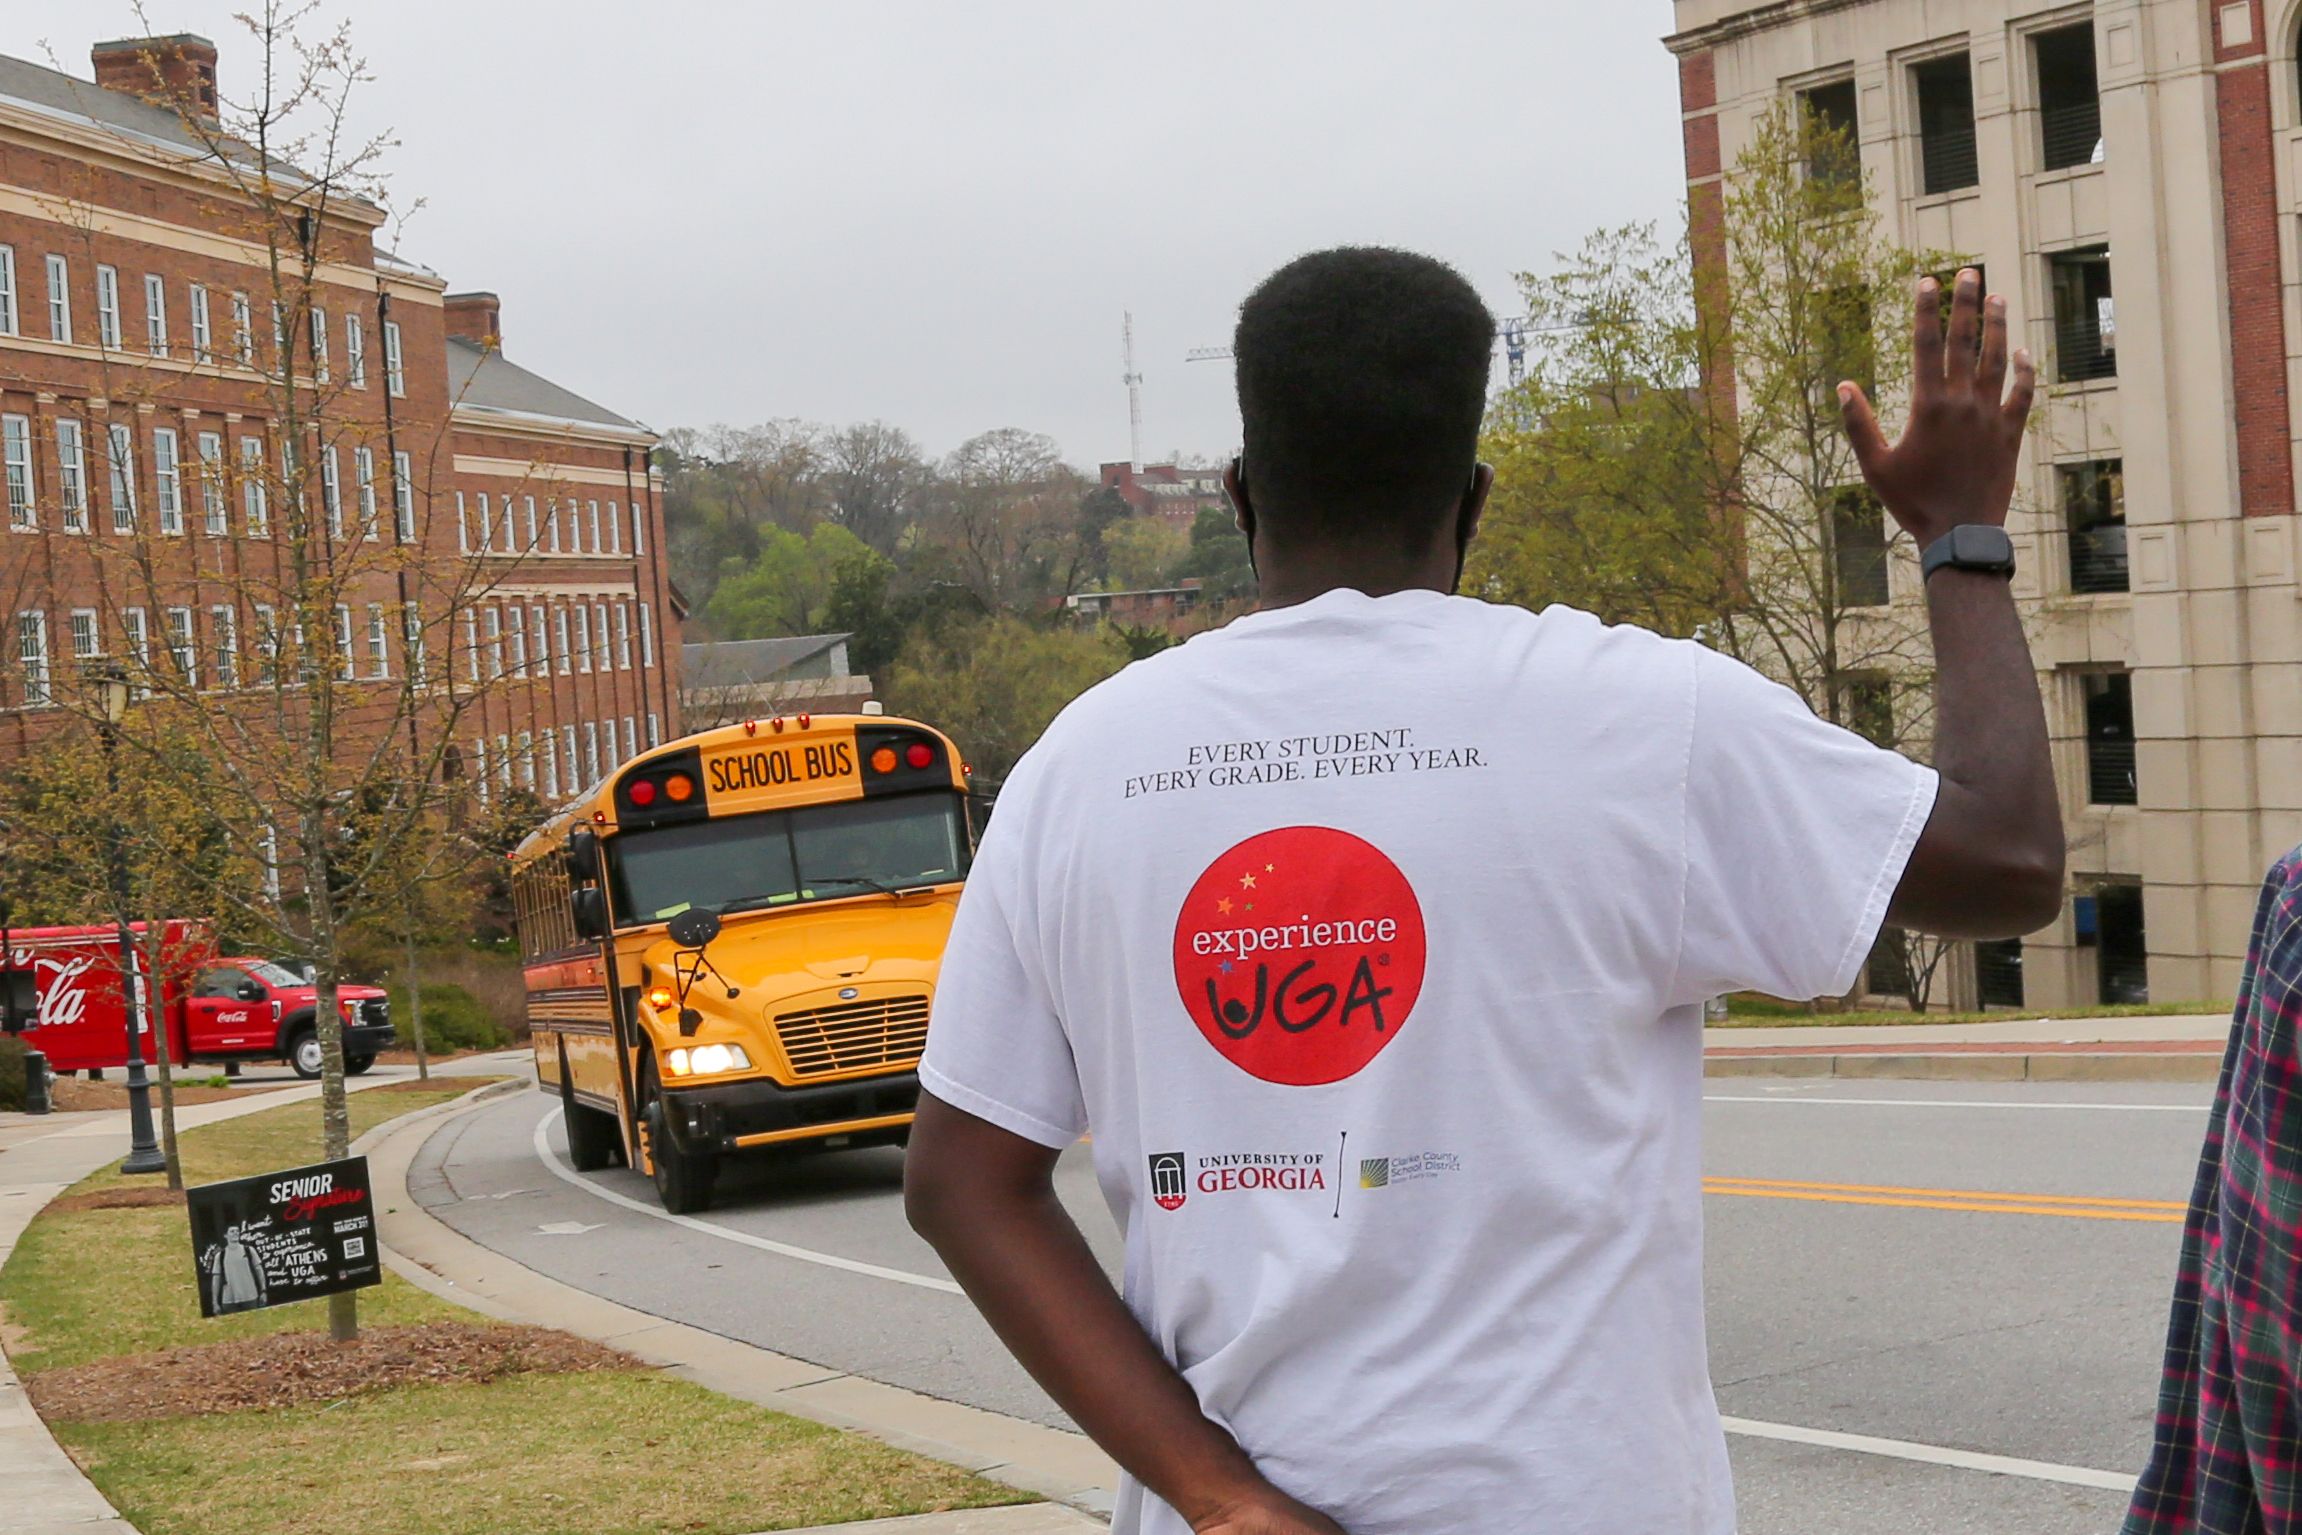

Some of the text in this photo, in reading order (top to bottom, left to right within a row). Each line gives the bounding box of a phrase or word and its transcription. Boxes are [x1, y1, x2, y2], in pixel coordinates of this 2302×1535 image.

[1187, 728, 1414, 765] EVERY STUDENT.
[709, 742, 852, 792] SCHOOL BUS
[1125, 747, 1488, 799] EVERY GRADE. EVERY YEAR.
[1192, 914, 1397, 960] experience
[1206, 956, 1393, 1039] UGA
[1199, 1154, 1324, 1168] UNIVERSITY OF
[1391, 1161, 1460, 1177] School District
[1423, 1151, 1459, 1163] County
[270, 1173, 333, 1204] SENIOR
[1197, 1167, 1326, 1193] GEORGIA
[285, 1248, 328, 1267] ATHENS
[291, 1265, 315, 1277] UGA
